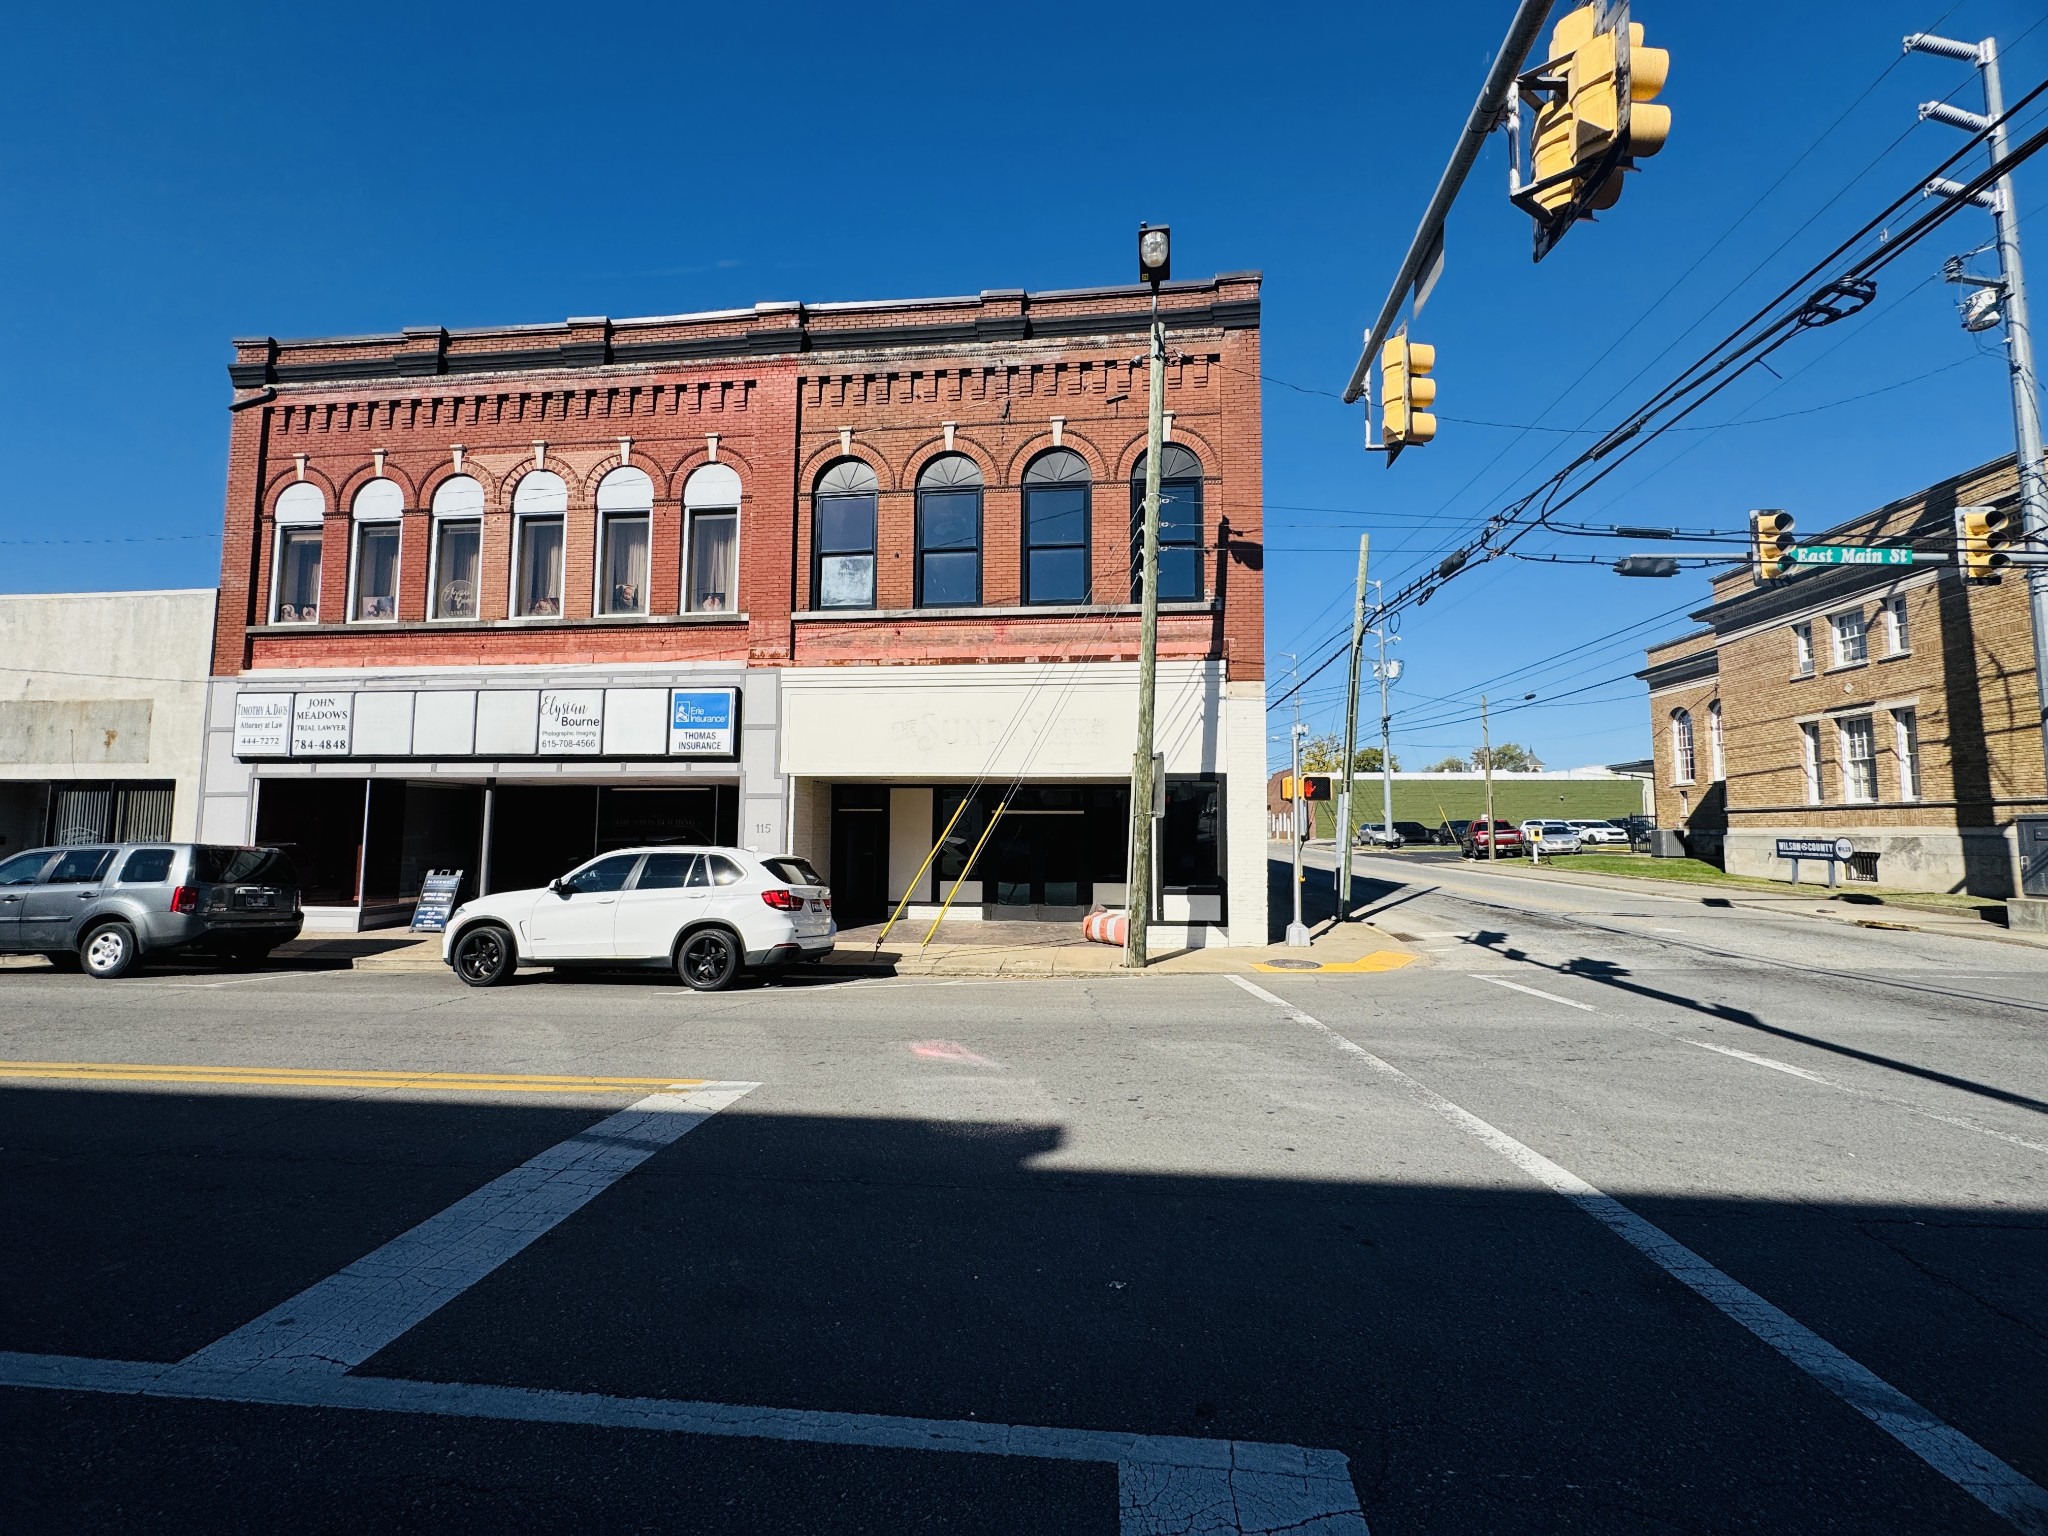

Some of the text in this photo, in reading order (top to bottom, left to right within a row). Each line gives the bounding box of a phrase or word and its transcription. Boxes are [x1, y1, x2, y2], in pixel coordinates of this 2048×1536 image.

[1797, 548, 1907, 563] East Main St
[307, 698, 336, 710] JOHN
[540, 695, 589, 722] Elysian
[265, 703, 273, 716] A.
[691, 706, 704, 715] Erie
[296, 710, 348, 720] MEADOWS
[690, 715, 726, 723] Insurance
[240, 720, 283, 731] Attorney at Law
[561, 716, 600, 727] Bourne
[296, 724, 347, 732] TRIAL LAWYER
[541, 730, 597, 738] Photographic Imaging
[684, 731, 717, 740] THOMAS
[241, 737, 280, 745] 444-7272
[294, 739, 347, 750] 784-4848
[541, 739, 596, 748] 615-708-4566
[678, 741, 722, 750] INSURANCE
[755, 823, 771, 834] 115
[1778, 841, 1834, 852] WILSON COUNTY
